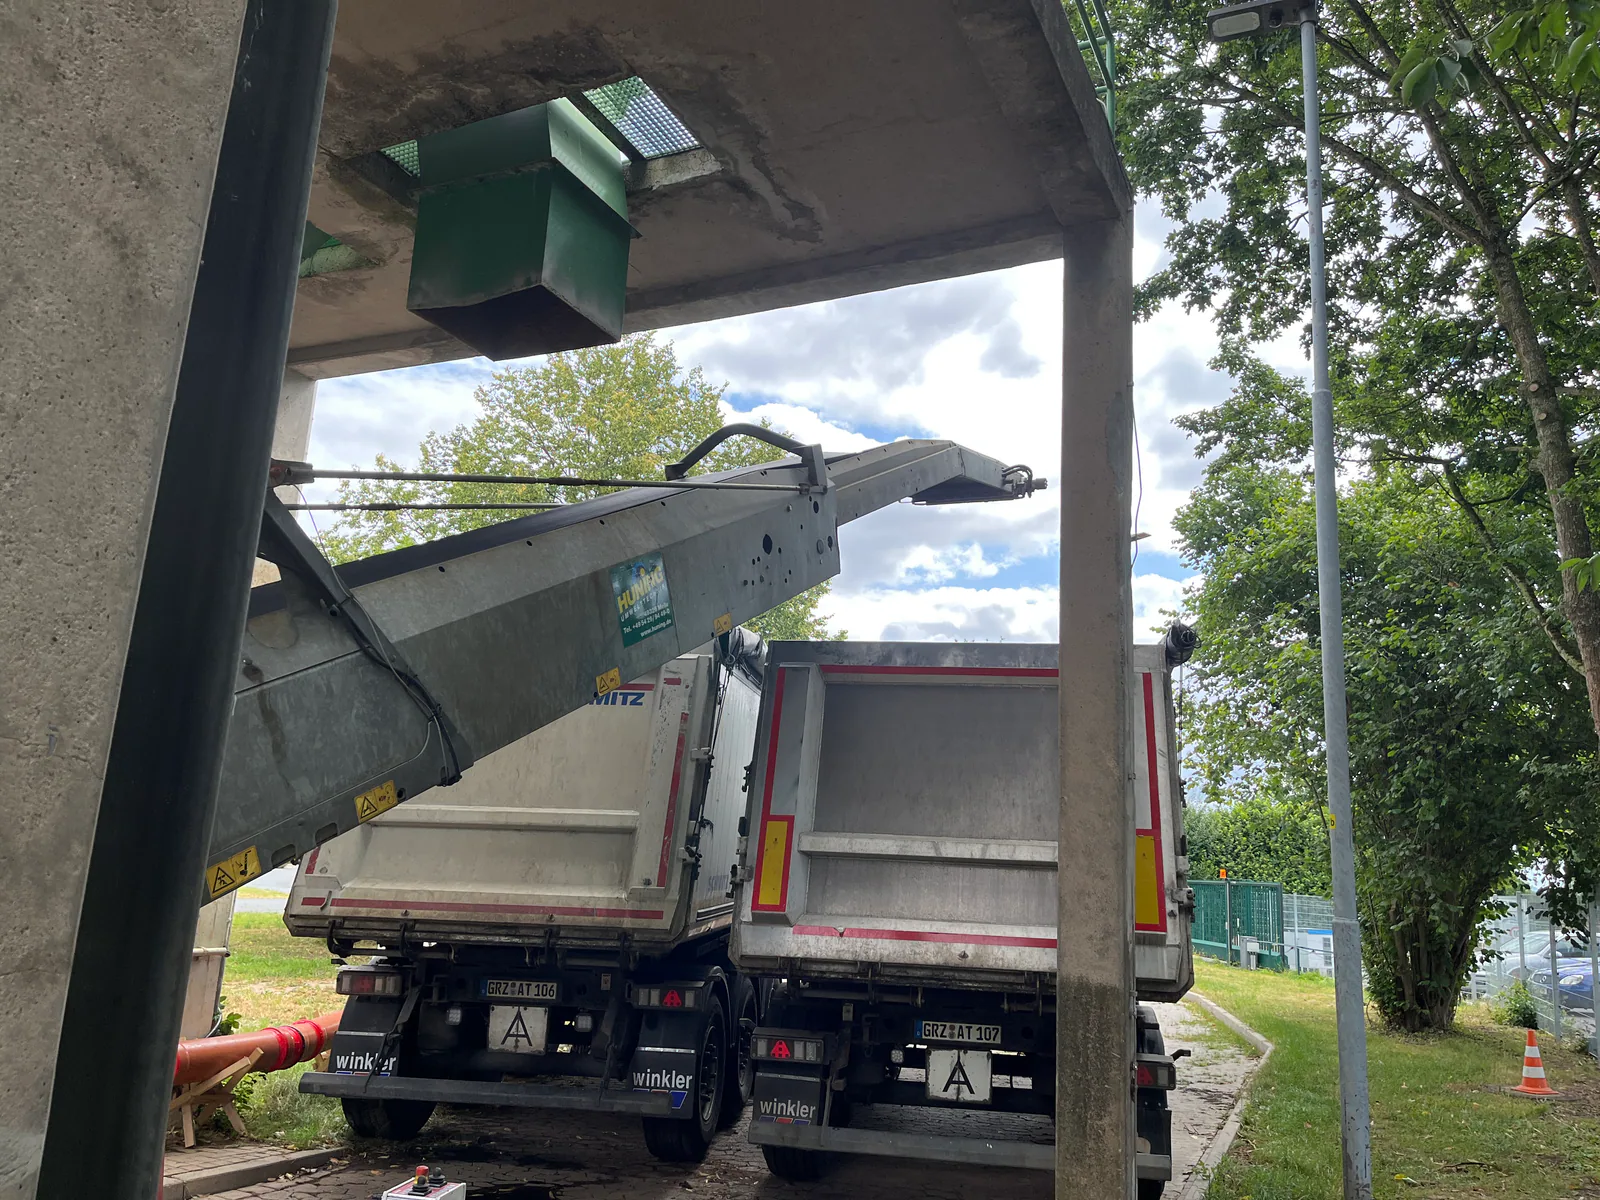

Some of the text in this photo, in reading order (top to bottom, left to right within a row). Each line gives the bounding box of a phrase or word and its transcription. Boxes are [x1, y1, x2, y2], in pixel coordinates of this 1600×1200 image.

[487, 981, 556, 998] GRZ AT 106
[500, 1008, 533, 1047] A
[923, 1022, 948, 1039] GRZ
[957, 1025, 973, 1040] AT
[976, 1026, 1000, 1042] 107
[633, 1068, 693, 1089] winkler
[942, 1057, 976, 1095] A
[760, 1097, 816, 1118] winkler
